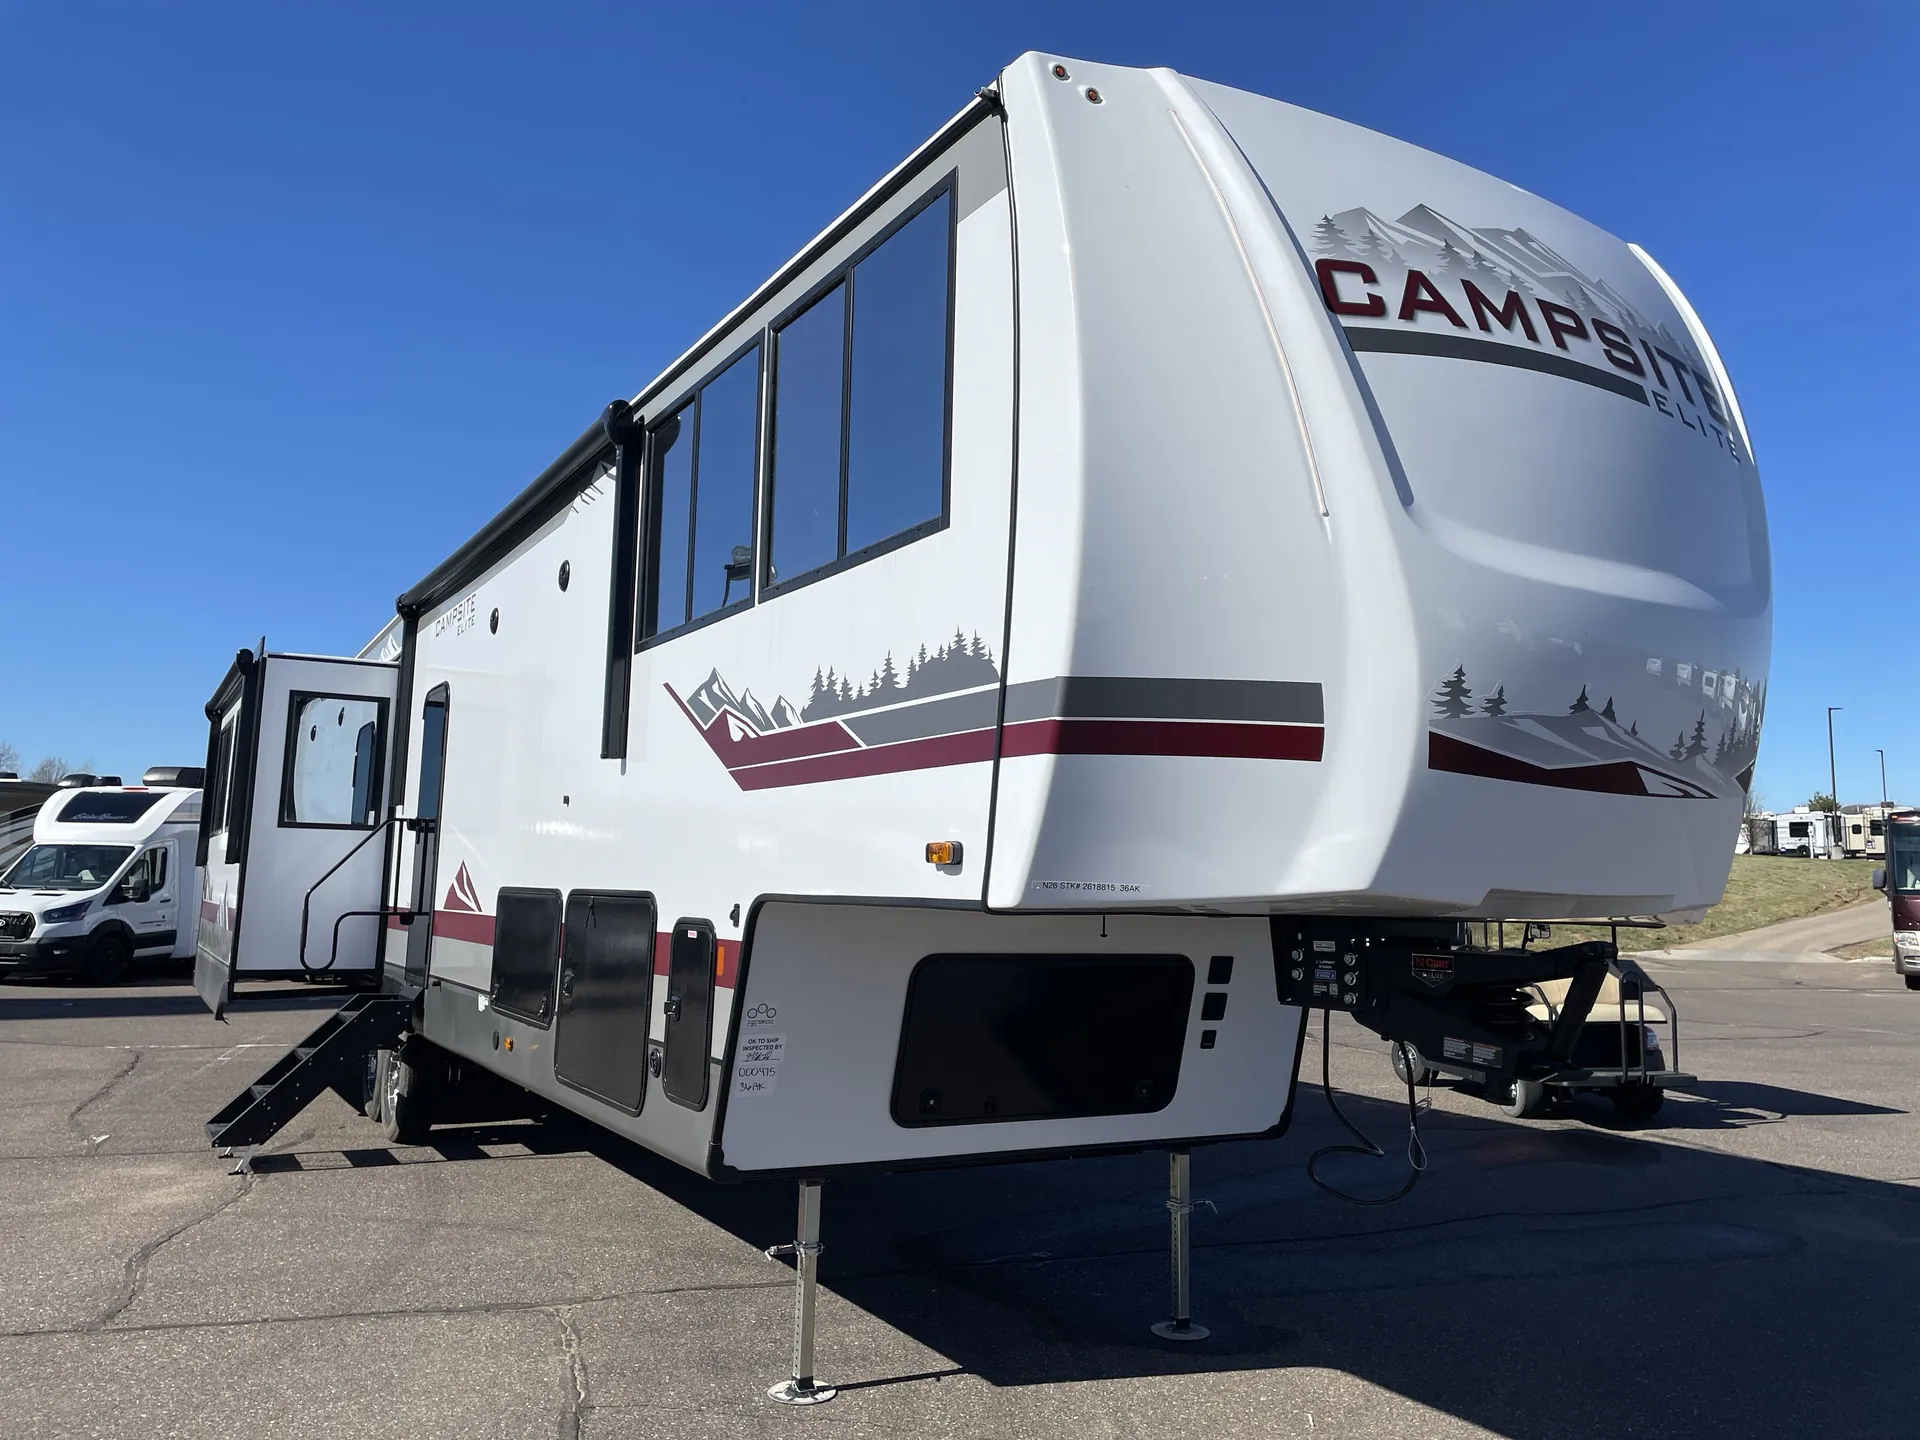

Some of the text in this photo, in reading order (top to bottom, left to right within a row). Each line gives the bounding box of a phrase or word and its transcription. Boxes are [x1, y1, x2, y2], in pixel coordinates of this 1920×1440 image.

[1314, 258, 1731, 428] CAMPSITE
[1651, 389, 1741, 464] ELITE
[435, 593, 477, 638] CAMPSITE
[456, 614, 476, 637] ELITE
[1042, 881, 1141, 893] N26 STK# 2618815 36AK
[742, 1044, 774, 1052] INSPECTED
[739, 1082, 767, 1093] 36AK
